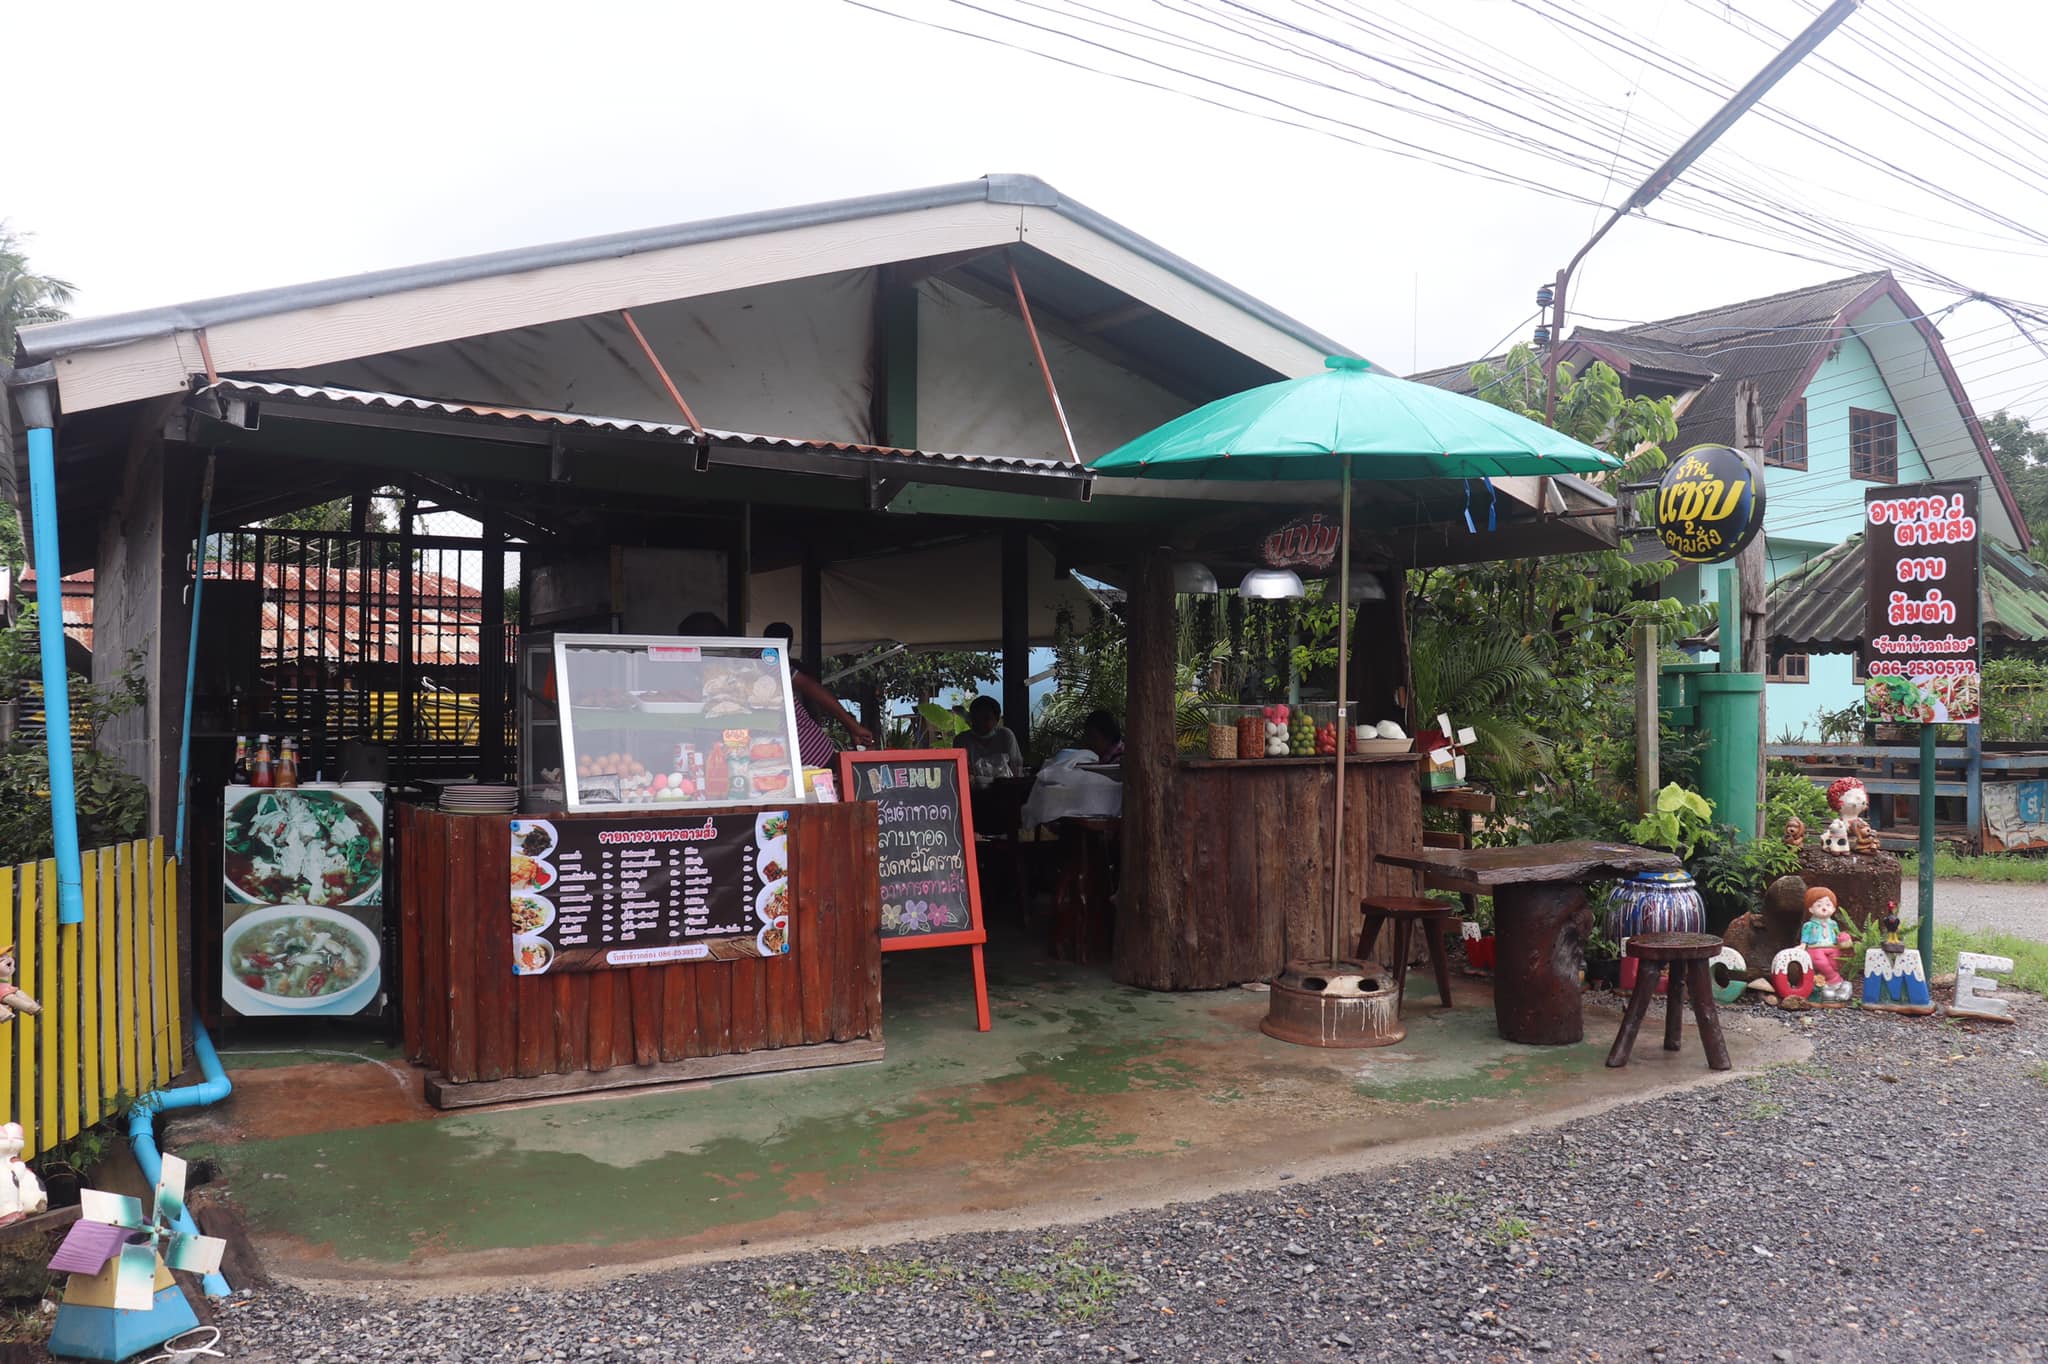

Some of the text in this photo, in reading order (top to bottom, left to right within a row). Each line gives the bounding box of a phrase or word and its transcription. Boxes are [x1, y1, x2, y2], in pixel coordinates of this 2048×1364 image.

[1676, 456, 1709, 480] ร้าน
[1868, 498, 1945, 523] อาหาร
[1896, 495, 1975, 544] ตามสั่ง
[1666, 526, 1721, 552] ตามสั่ง
[1898, 558, 1946, 581] ลาบ
[1889, 589, 1954, 624] ส้มตำ
[1870, 661, 1975, 676] 086-2530577
[867, 765, 941, 794] MENU
[878, 800, 951, 825] ส้มตำทอด
[599, 817, 717, 843] รายการอาหารตามสั่ง
[878, 830, 948, 848] ลาบทอด
[879, 847, 962, 877] ผัดหมี่โคราช
[880, 871, 966, 899] อาหารตามสั่ง
